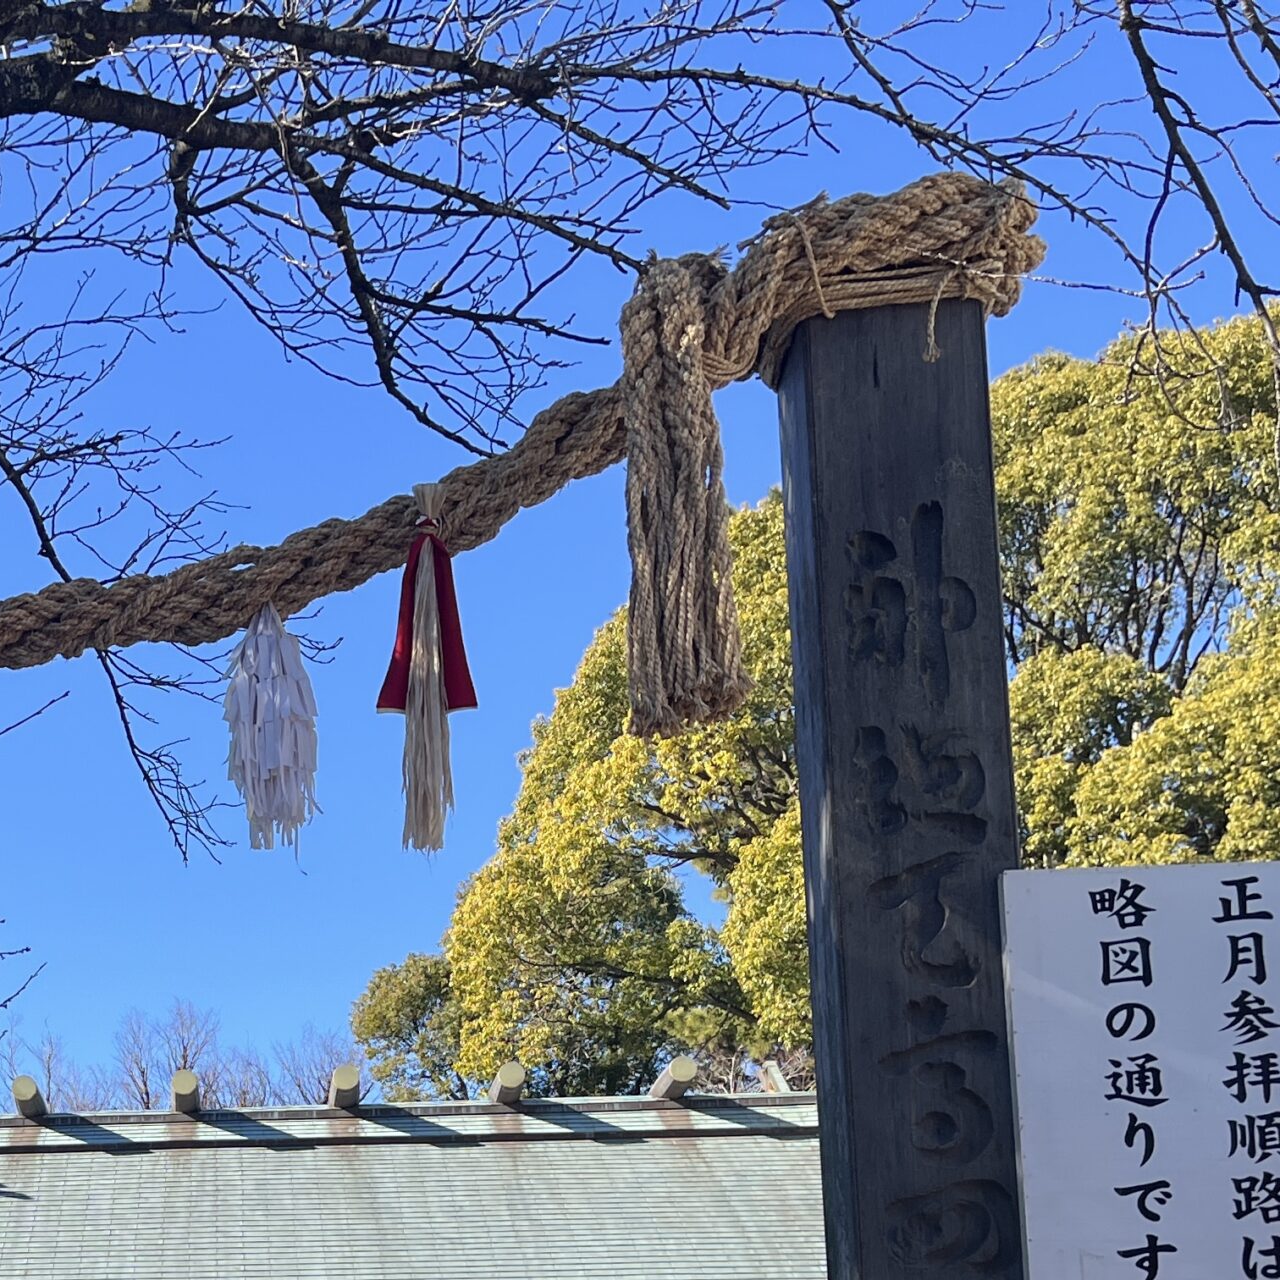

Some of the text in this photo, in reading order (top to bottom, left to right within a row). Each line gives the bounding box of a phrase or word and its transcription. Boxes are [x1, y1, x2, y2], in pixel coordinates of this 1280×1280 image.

[1212, 875, 1280, 1280] 正月参拝順路は
